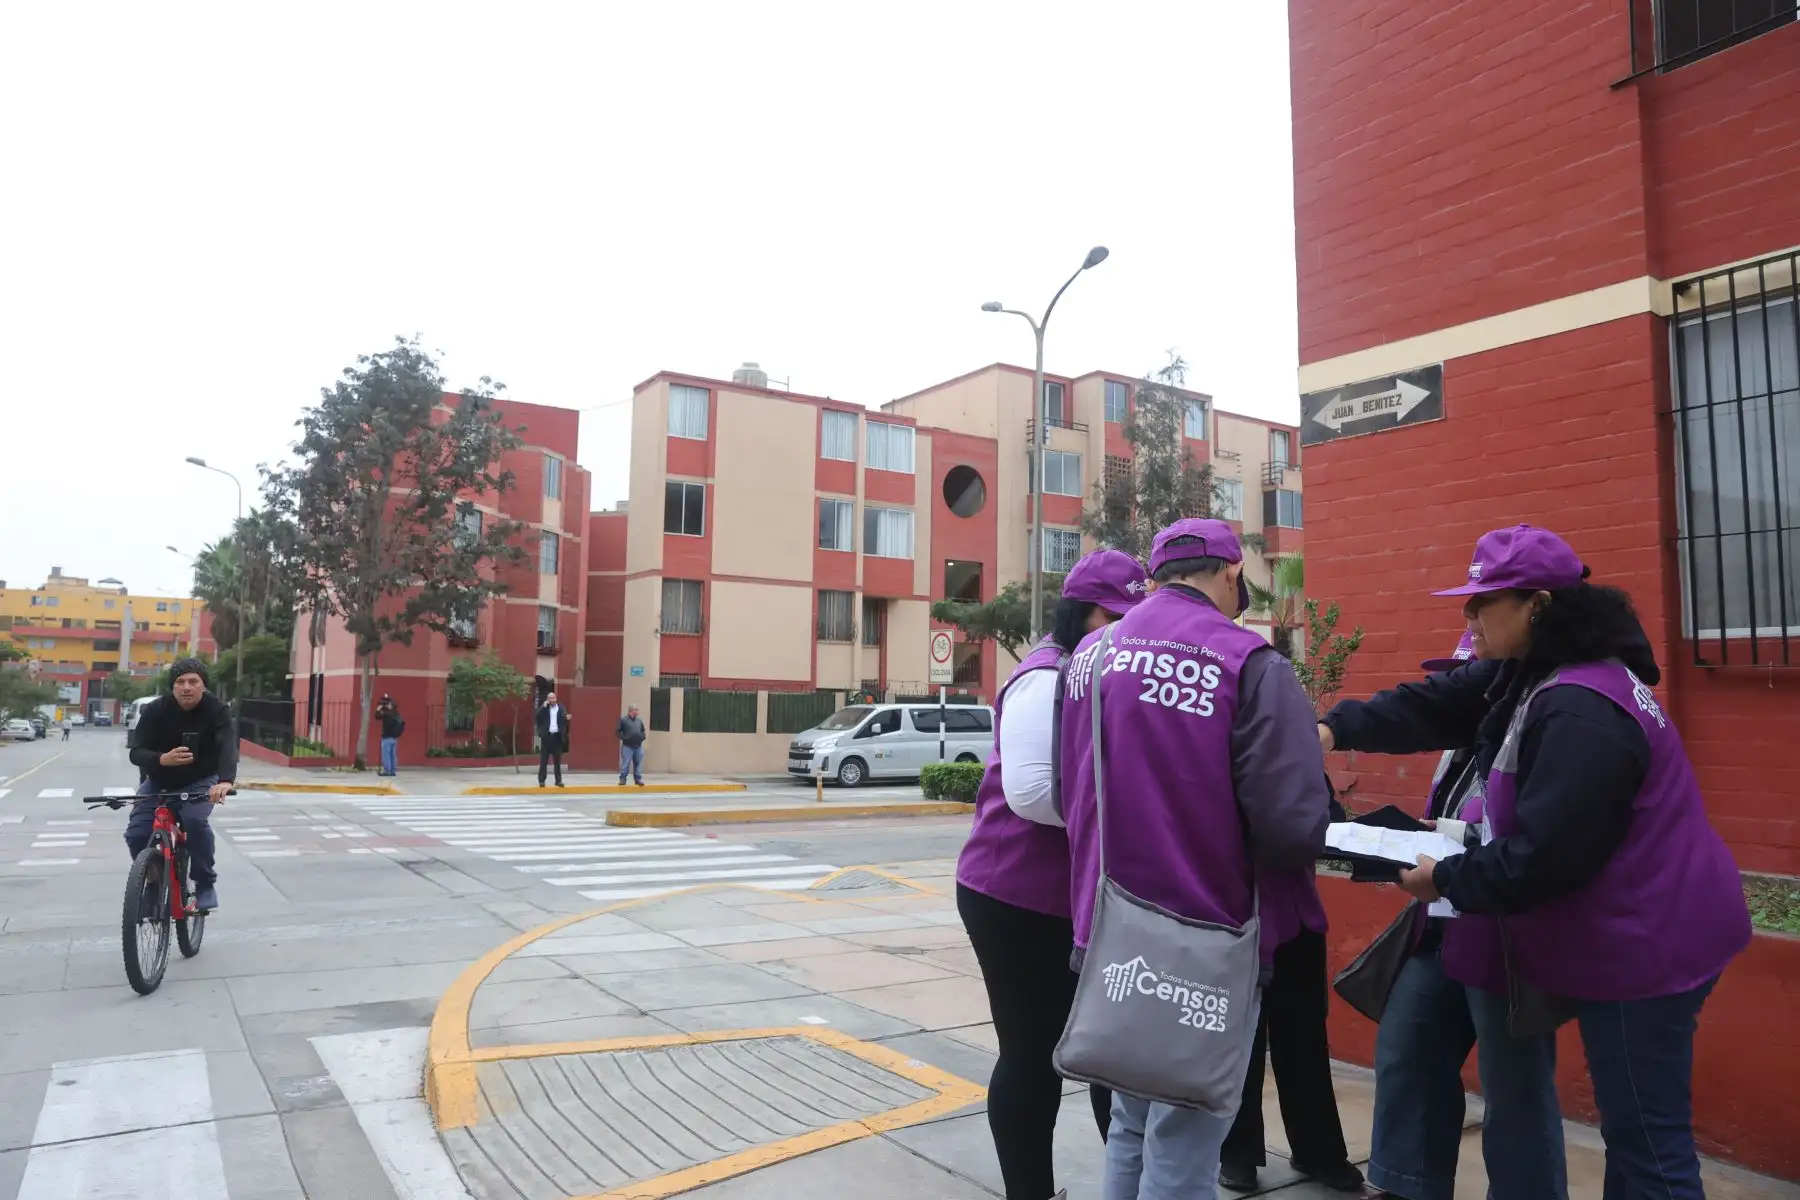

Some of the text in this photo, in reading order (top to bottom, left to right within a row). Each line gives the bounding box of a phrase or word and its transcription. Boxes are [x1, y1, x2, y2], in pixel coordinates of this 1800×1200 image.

[1332, 394, 1402, 419] JUAN BENITEZ
[1120, 635, 1147, 647] Todos
[1149, 638, 1199, 654] sumamos
[1139, 679, 1214, 717] 2025
[1136, 971, 1229, 1015] Censos
[1160, 971, 1182, 984] Todos
[1184, 980, 1217, 993] sumamos
[1178, 1007, 1226, 1033] 2025
